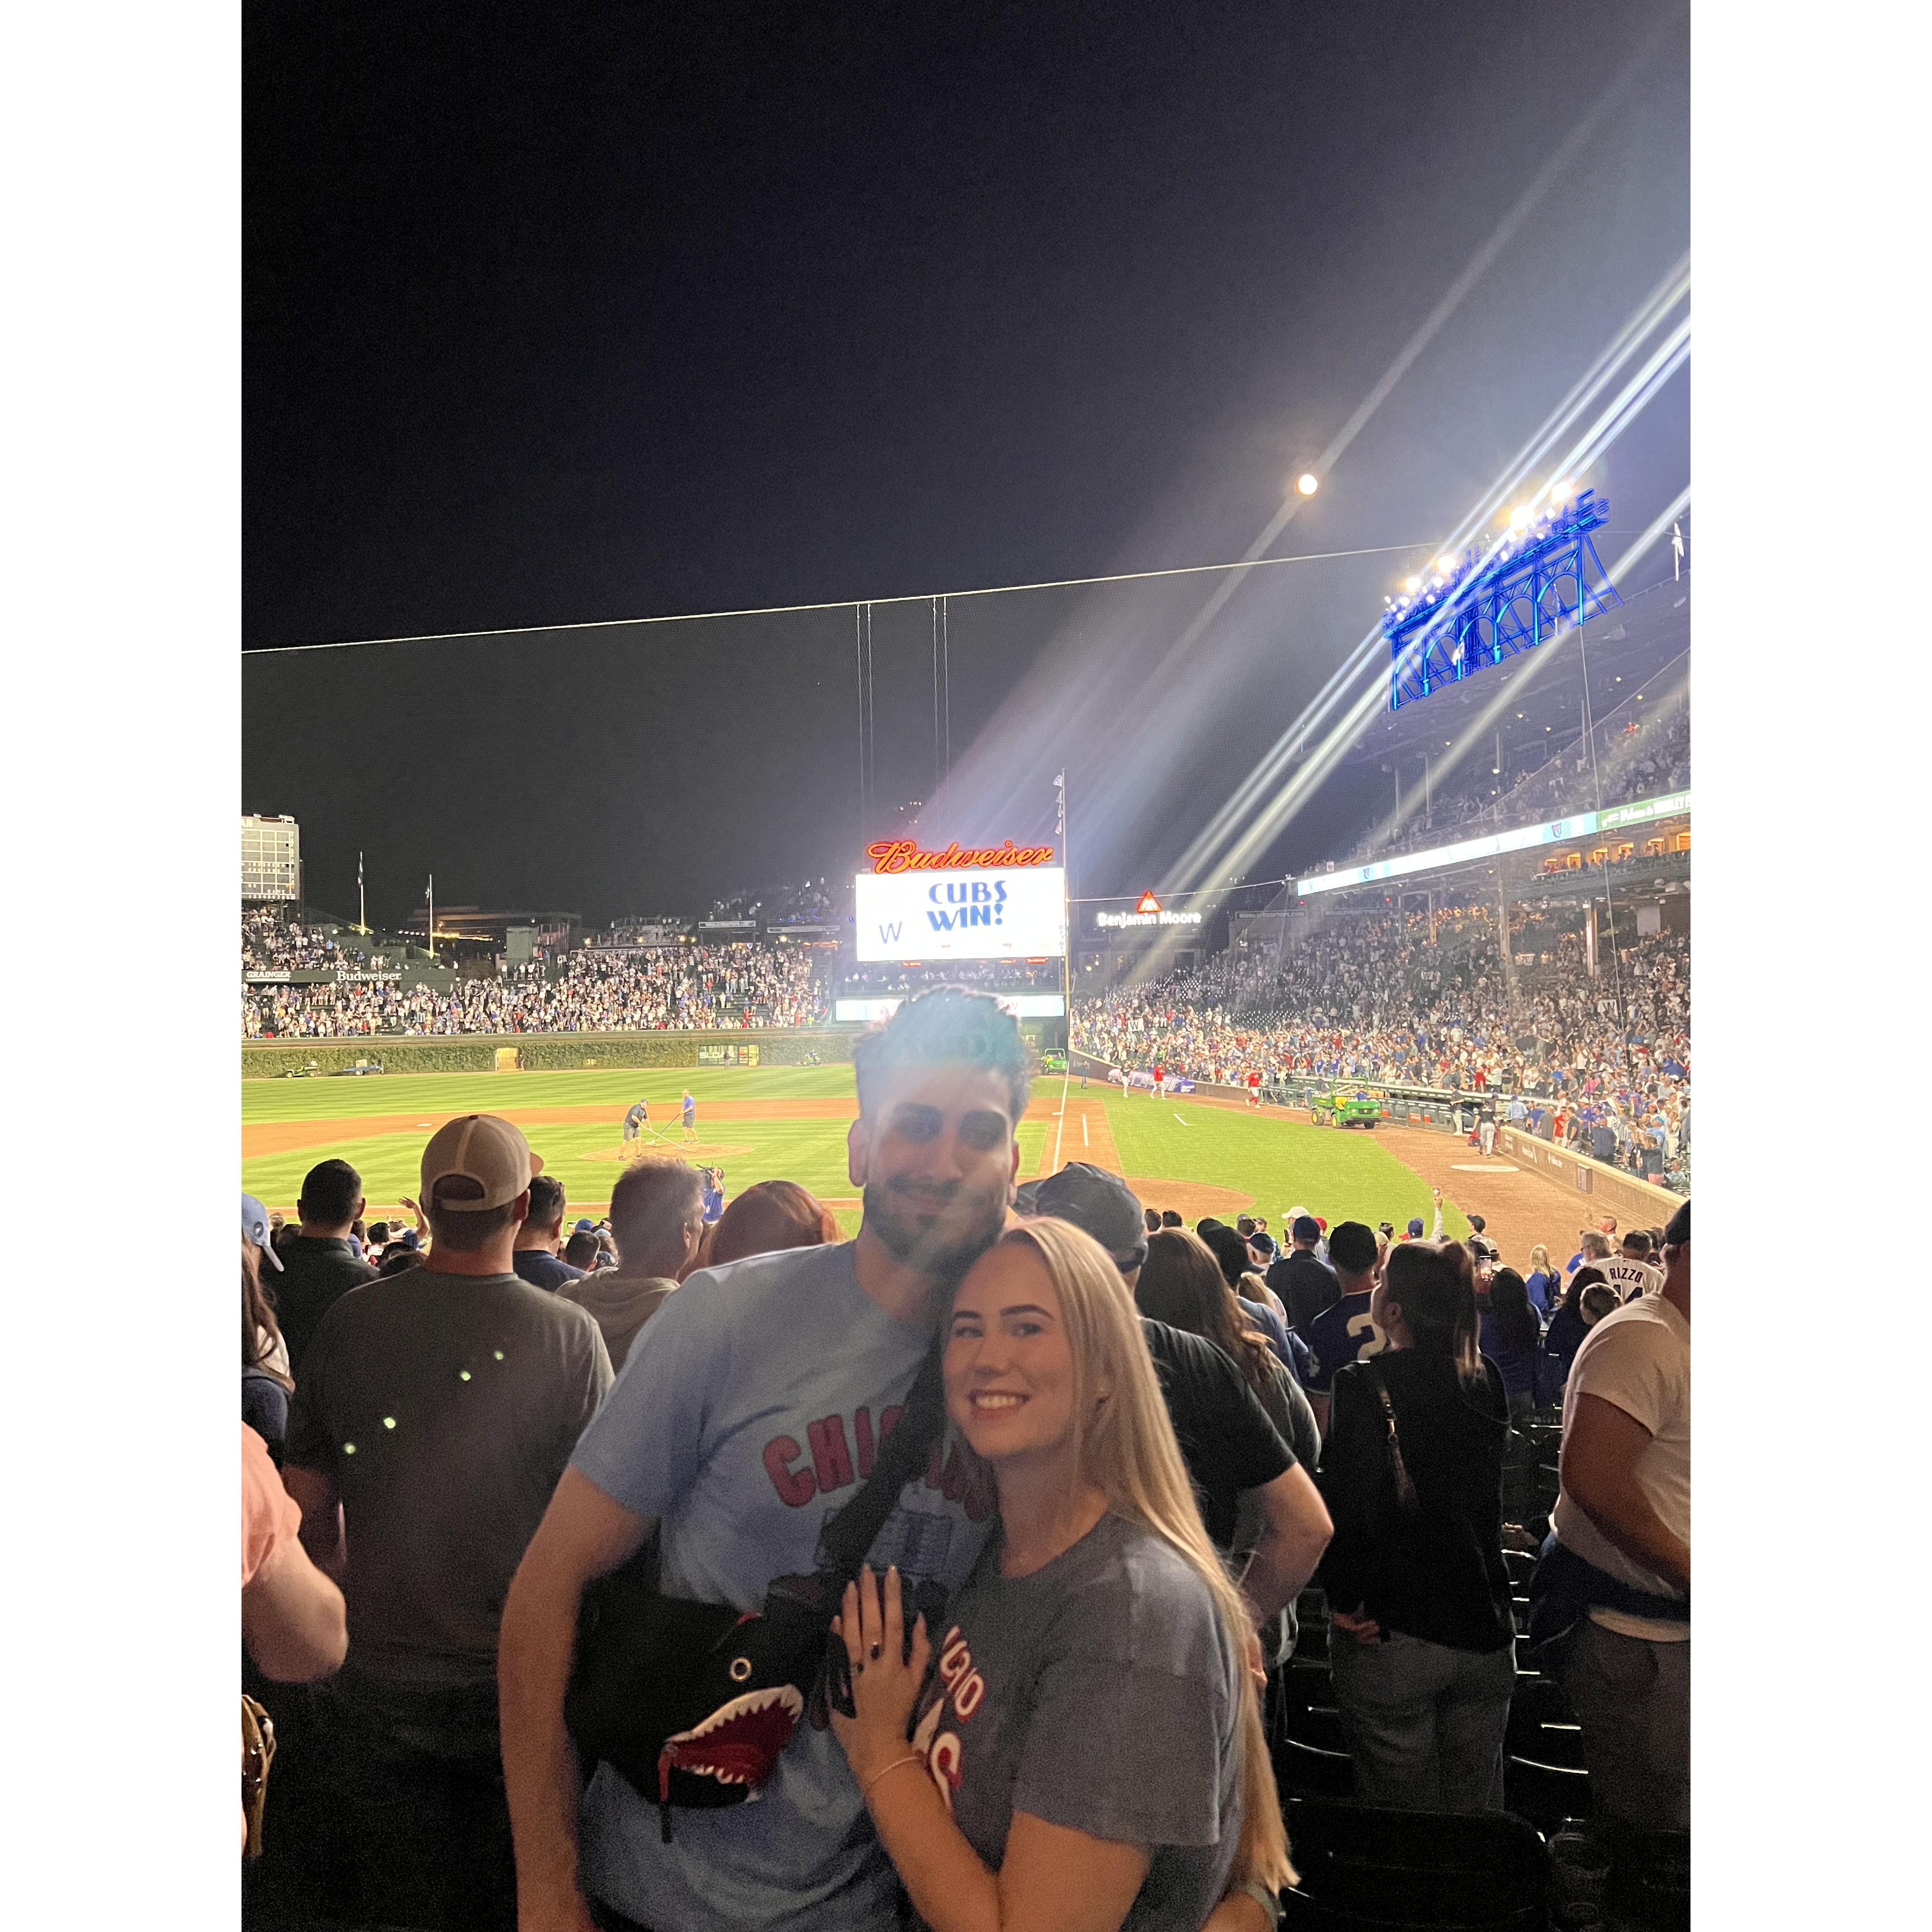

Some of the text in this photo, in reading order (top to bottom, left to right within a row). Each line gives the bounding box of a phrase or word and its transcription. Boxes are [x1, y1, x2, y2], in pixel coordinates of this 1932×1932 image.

[867, 840, 1053, 874] Budweiser
[929, 881, 1007, 904] CUBS
[926, 903, 1003, 932] WIN!
[1097, 911, 1201, 928] Benjamin Moore
[879, 921, 902, 944] W
[336, 970, 401, 981] Budweiser
[1610, 1267, 1643, 1283] RIZZO
